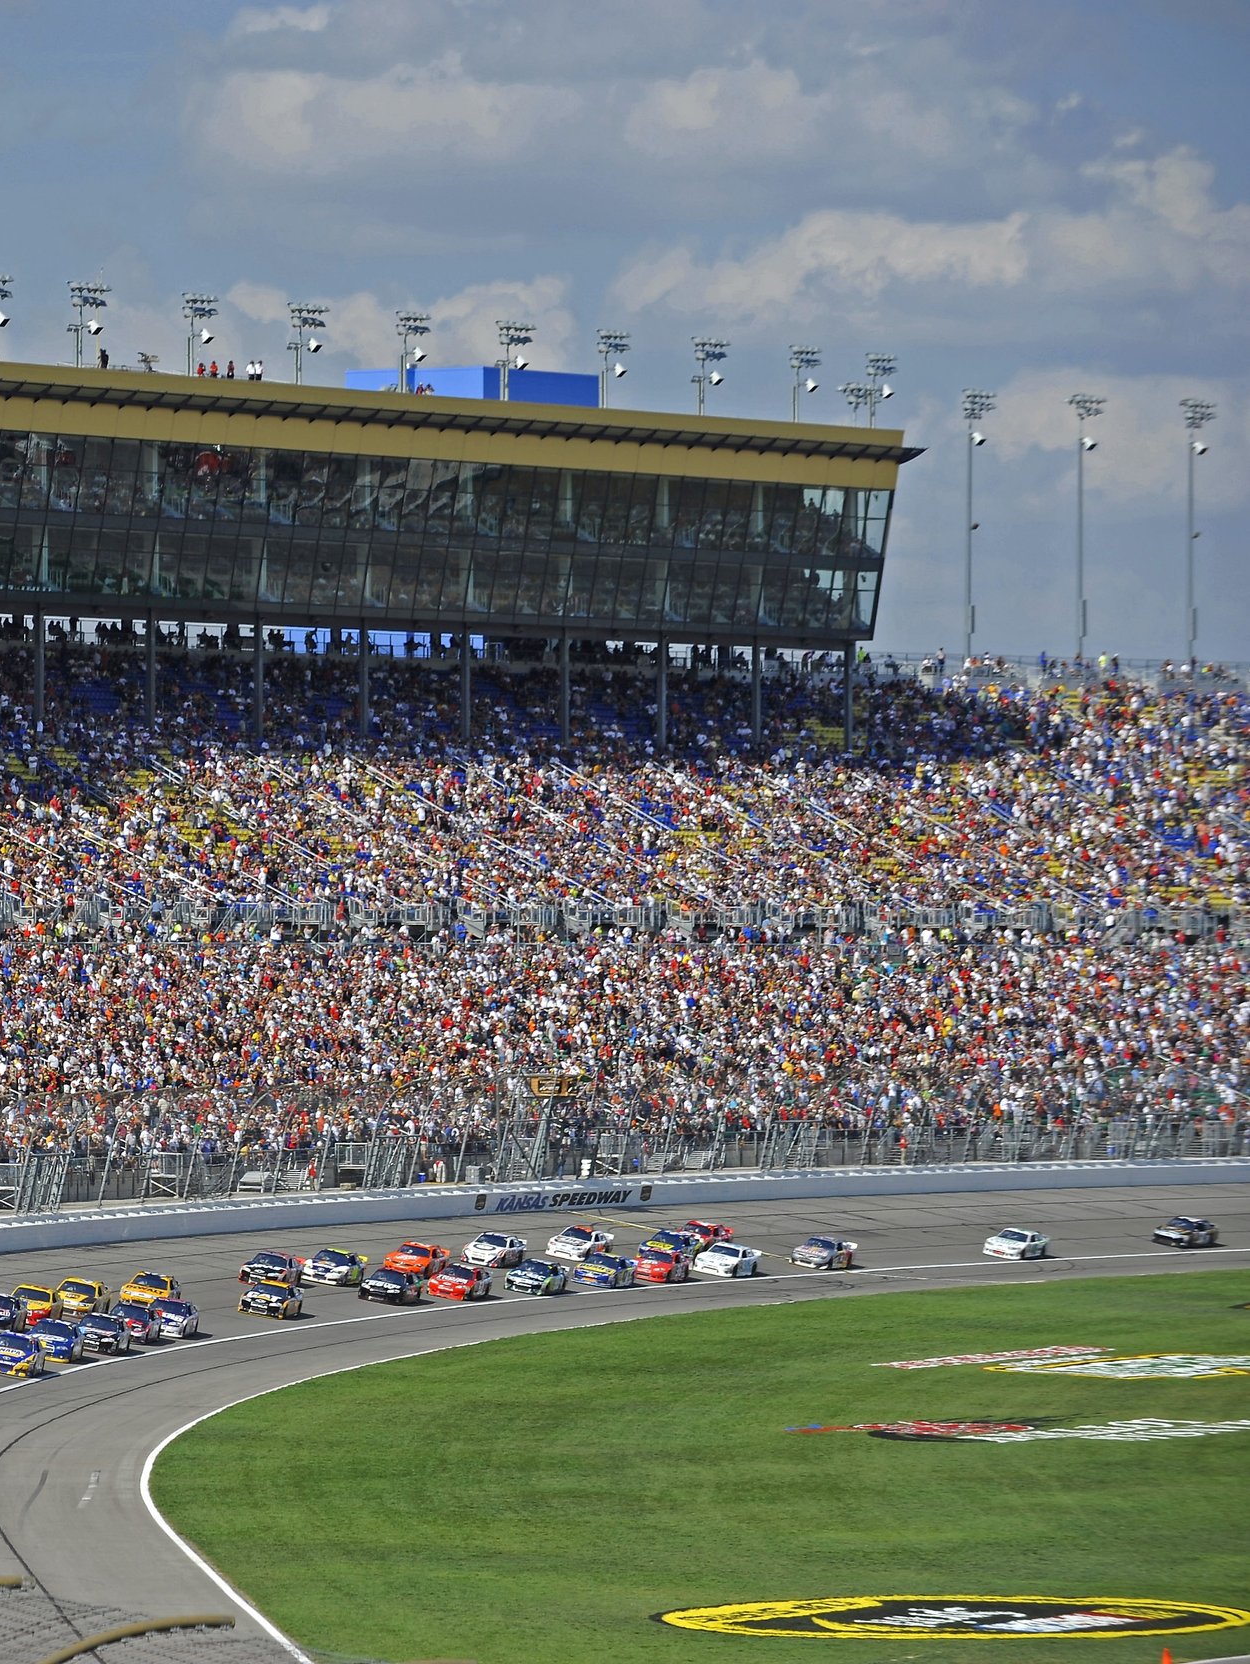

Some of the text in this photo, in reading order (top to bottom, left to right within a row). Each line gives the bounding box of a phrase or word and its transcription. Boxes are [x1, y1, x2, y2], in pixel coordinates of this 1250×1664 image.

[495, 1192, 549, 1212] KANSAS
[549, 1190, 632, 1207] SPEEDWAY
[246, 1291, 282, 1303] CAT
[0, 1347, 21, 1355] NAPA
